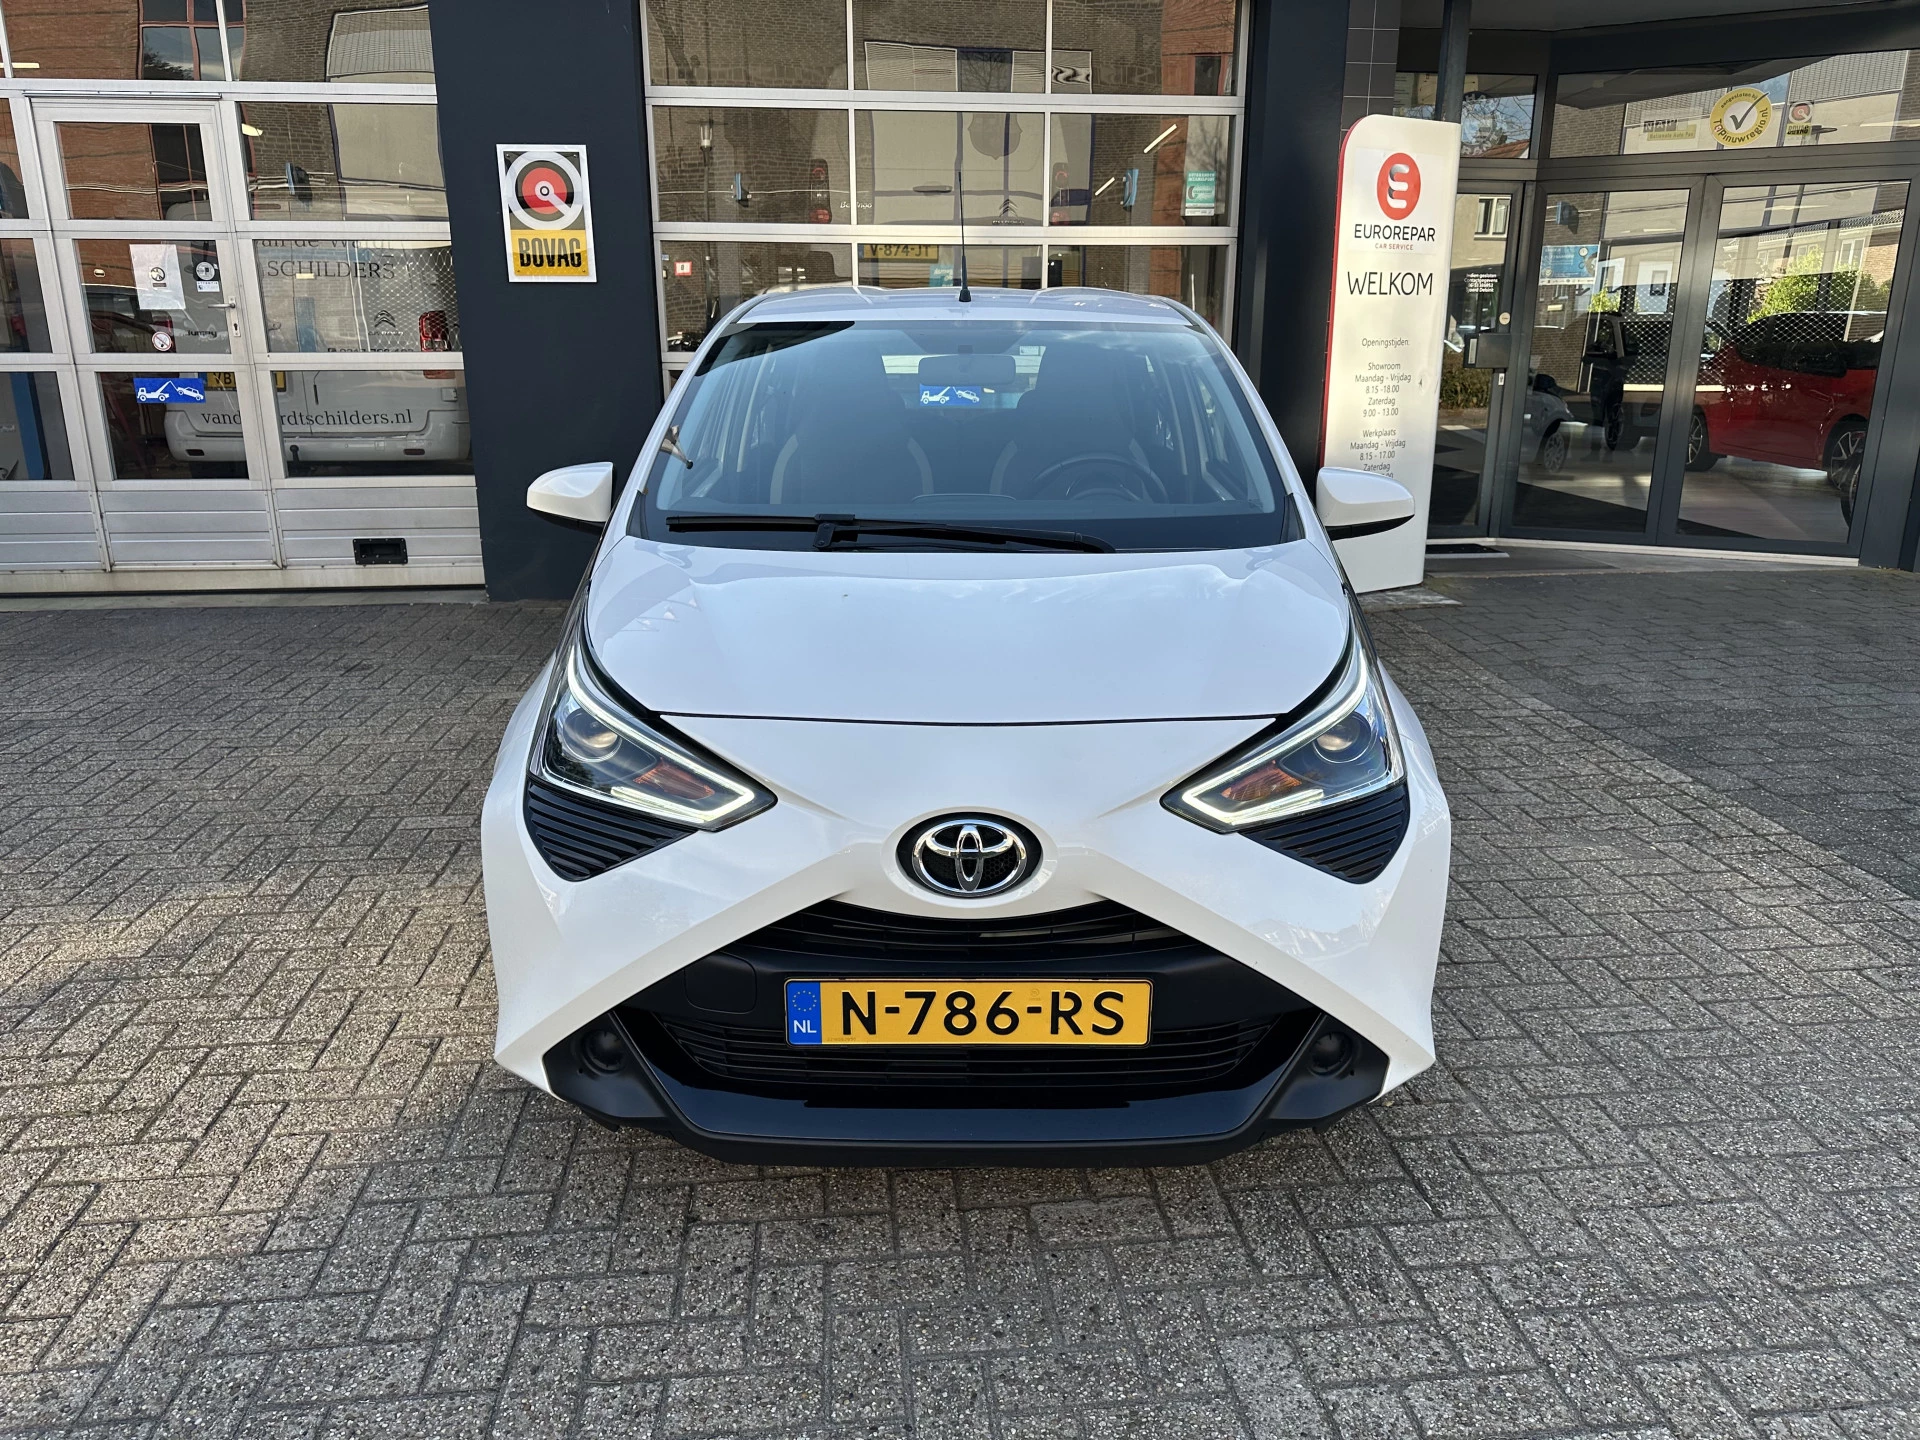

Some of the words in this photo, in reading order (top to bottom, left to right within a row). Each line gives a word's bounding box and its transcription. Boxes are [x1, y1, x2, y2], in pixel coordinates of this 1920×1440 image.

[1354, 224, 1436, 242] EUROREPAR
[517, 237, 583, 268] BOVAG
[870, 244, 930, 257] V-874-JT
[1374, 242, 1388, 250] CAR
[1388, 243, 1414, 251] SERVICE
[266, 260, 396, 280] SCHILDERS
[1347, 271, 1434, 296] WELKOM
[1367, 362, 1401, 371] Showroom
[1354, 373, 1385, 385] Maandag
[1390, 373, 1412, 384] Vrijdag
[1365, 385, 1379, 394] 8.15
[1367, 397, 1396, 407] Zaterdag
[201, 408, 413, 427] vandrdtschilders.nl
[1362, 409, 1376, 418] 9.00
[1382, 407, 1399, 417] 13.00
[1362, 428, 1397, 439] Werkplaats
[1349, 440, 1379, 451] Maandag
[1385, 439, 1406, 449] Vrijdag
[1359, 452, 1373, 461] 8.15
[1379, 450, 1396, 460] 17.00
[1363, 462, 1391, 472] Zaterdag
[840, 990, 1125, 1037] N-786-RS
[793, 1019, 818, 1035] NL
